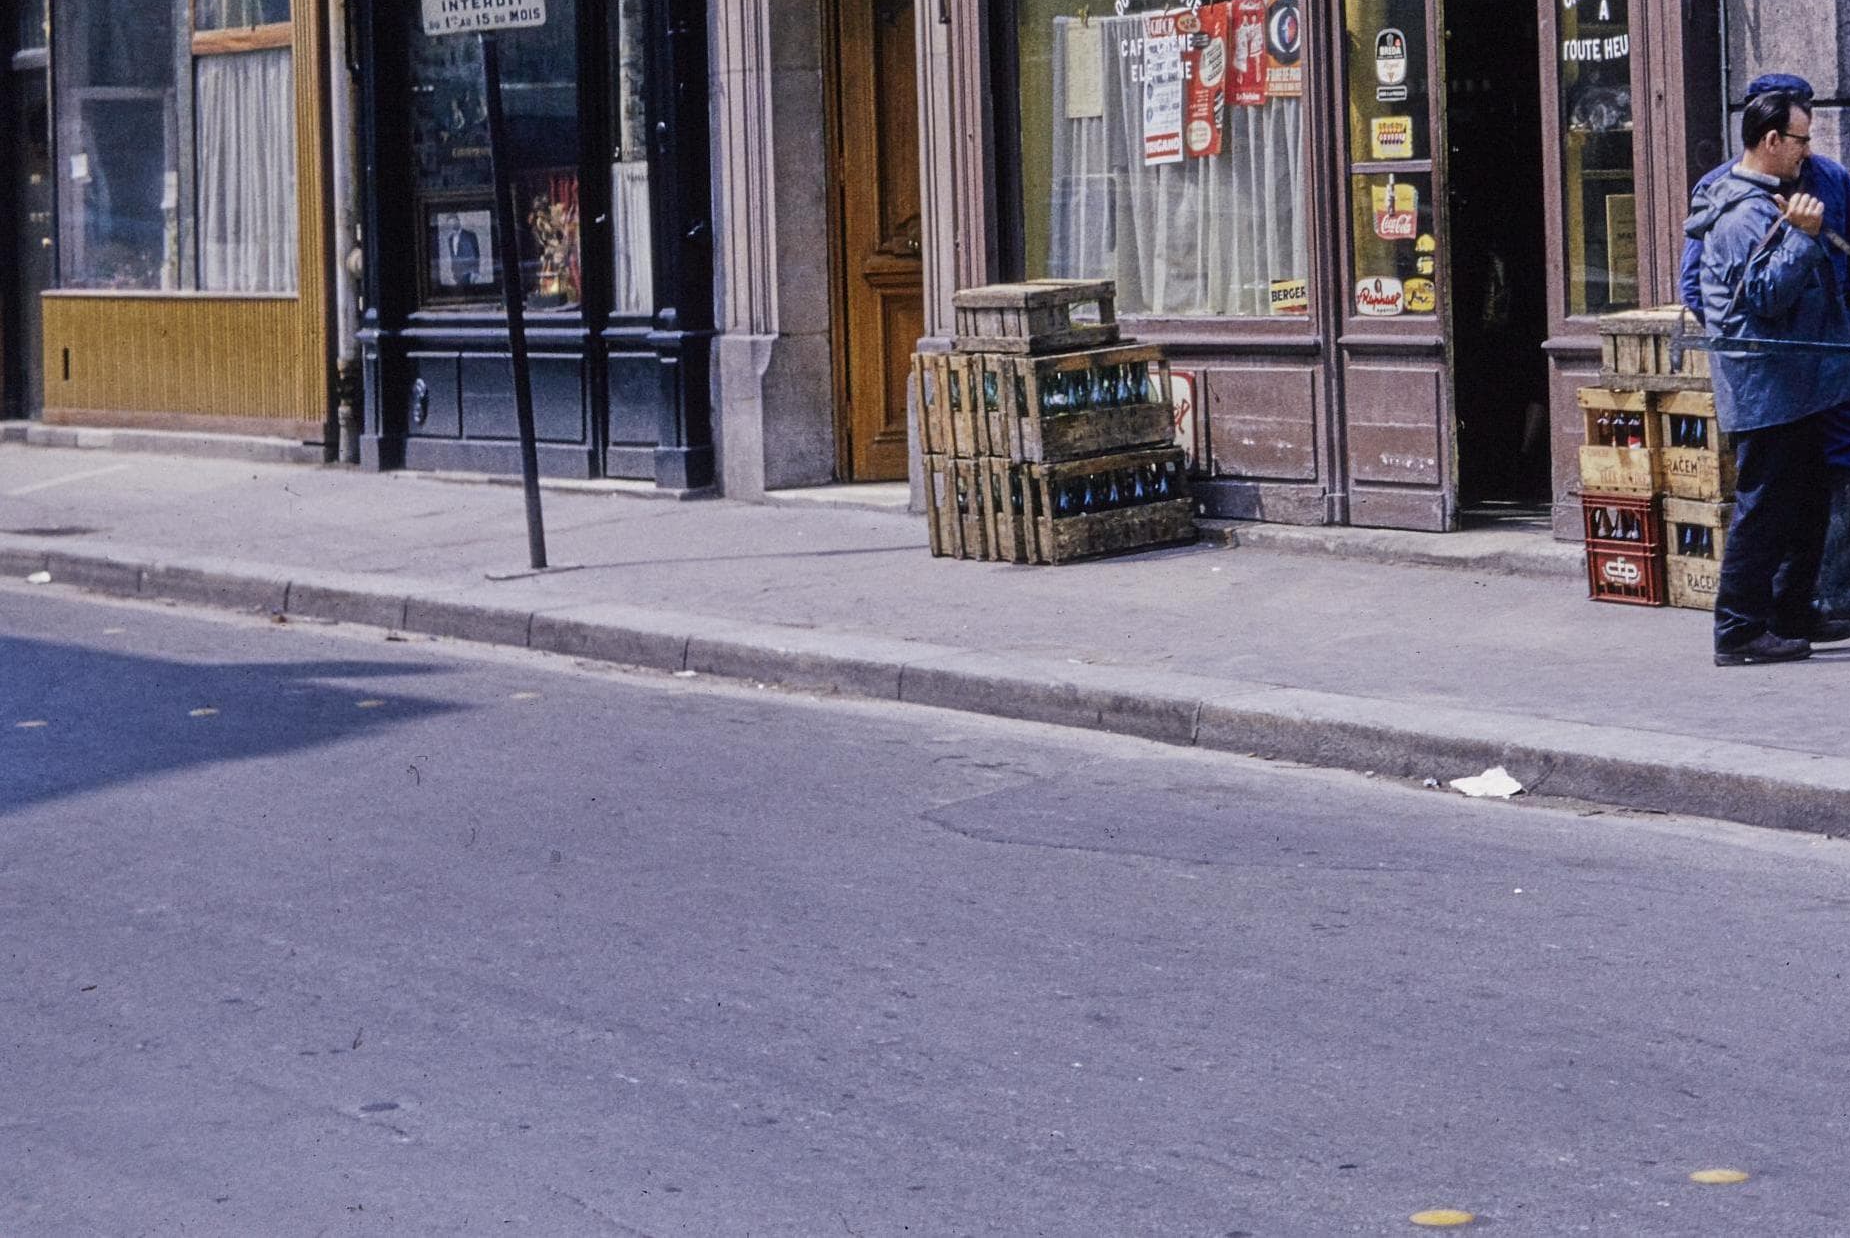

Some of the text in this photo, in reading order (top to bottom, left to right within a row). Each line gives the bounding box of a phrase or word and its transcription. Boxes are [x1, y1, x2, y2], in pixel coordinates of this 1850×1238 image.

[476, 12, 491, 26] 15
[510, 7, 542, 23] MOIS
[1599, 0, 1610, 21] A
[1563, 39, 1601, 61] TOUTE
[1271, 286, 1306, 303] BERGER
